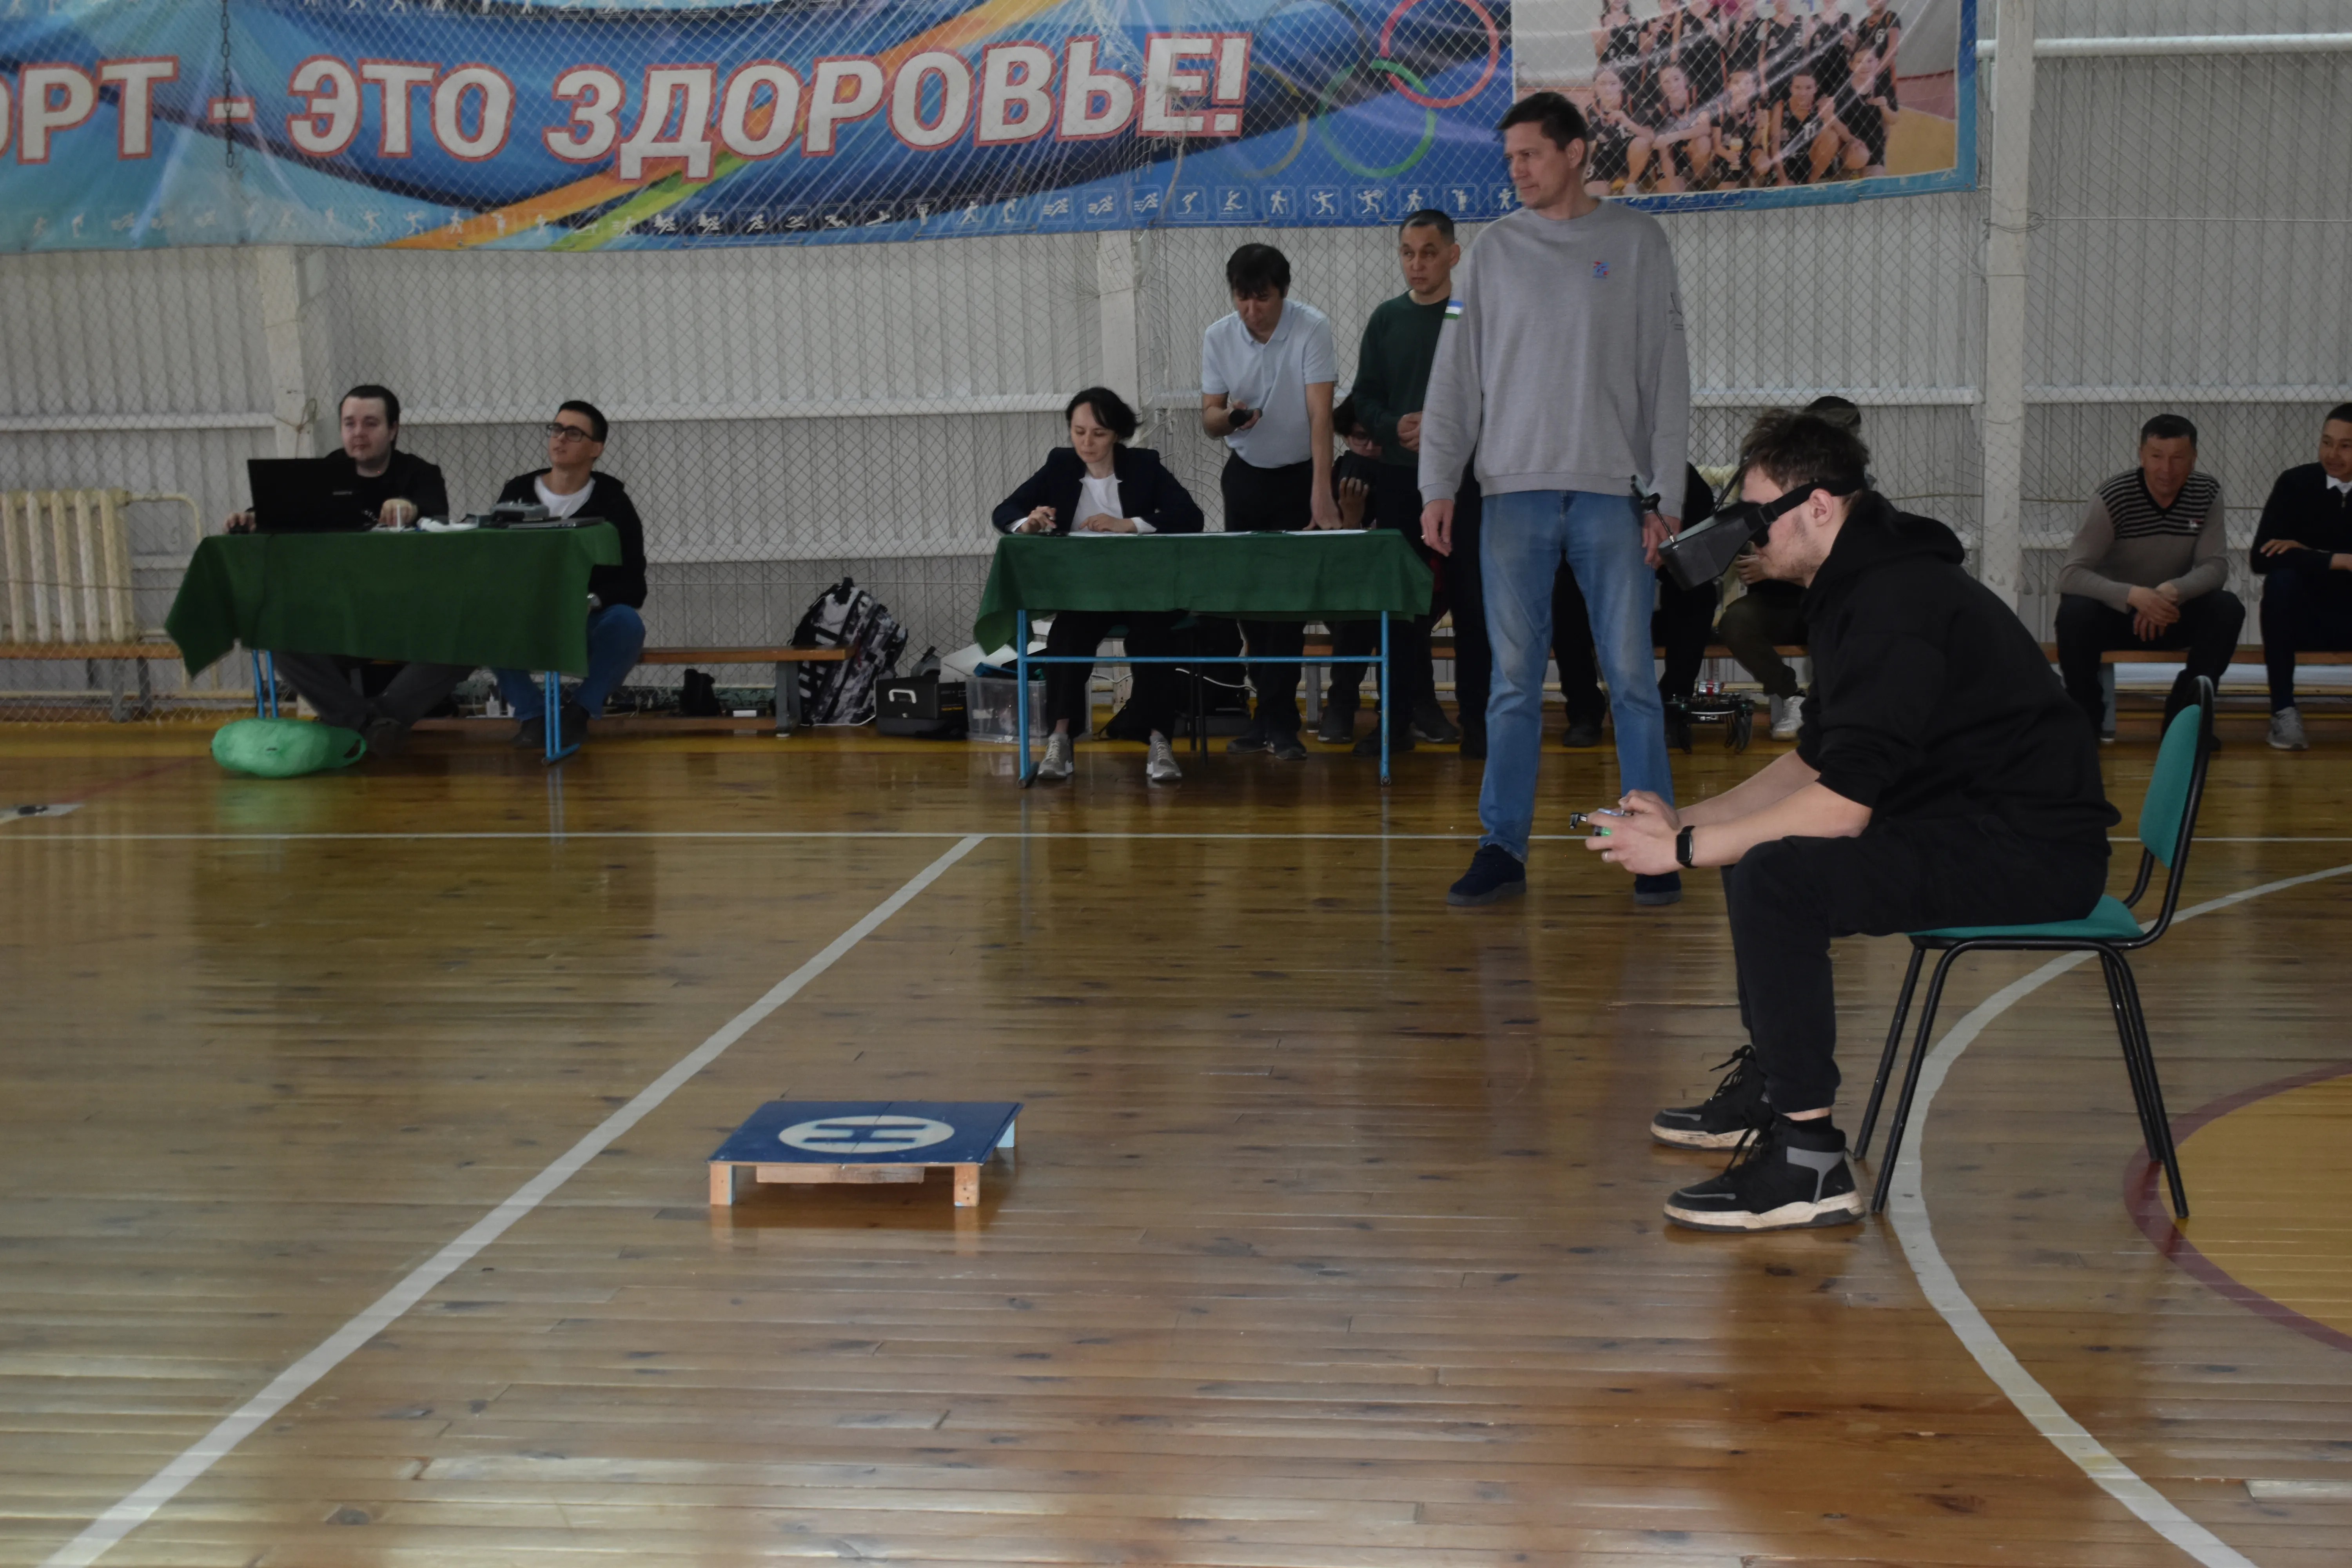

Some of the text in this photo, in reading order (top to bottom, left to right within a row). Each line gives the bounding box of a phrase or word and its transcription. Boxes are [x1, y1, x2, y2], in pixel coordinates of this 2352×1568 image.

[0, 55, 179, 165] РТ
[286, 54, 517, 163] ЭТО
[542, 32, 1253, 185] ЗДОРОВЬЕ!
[802, 1123, 926, 1144] H
